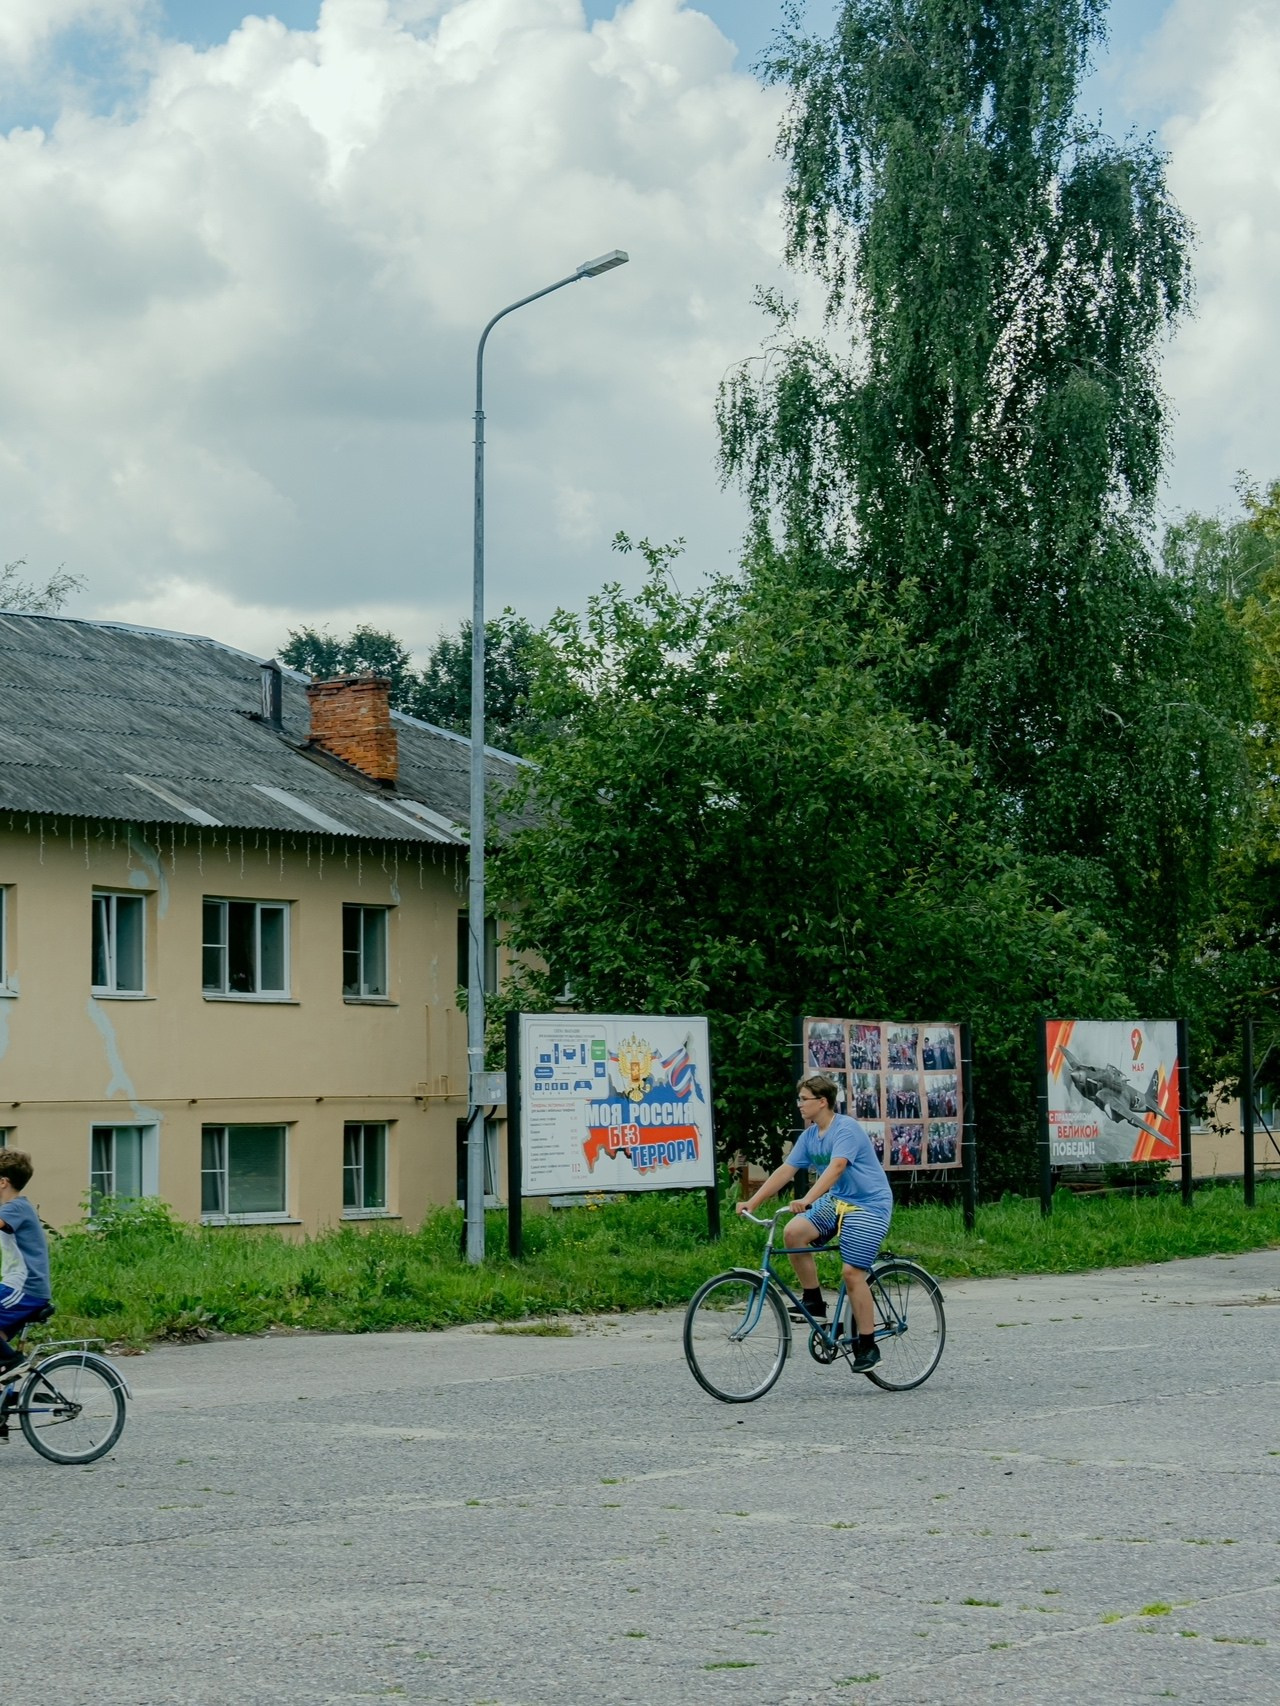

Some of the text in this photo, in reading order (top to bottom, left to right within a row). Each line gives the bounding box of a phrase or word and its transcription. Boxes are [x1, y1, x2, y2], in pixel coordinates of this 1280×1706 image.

[1132, 1063, 1144, 1072] МАЯ
[585, 1103, 623, 1127] МОЯ
[629, 1102, 696, 1126] РОССИЯ
[609, 1123, 640, 1149] БЕЗ
[1057, 1121, 1099, 1139] ВЕЛИКОЙ
[630, 1138, 697, 1168] ТЕРРОРА
[1052, 1141, 1096, 1158] ПОБЕДЫ!
